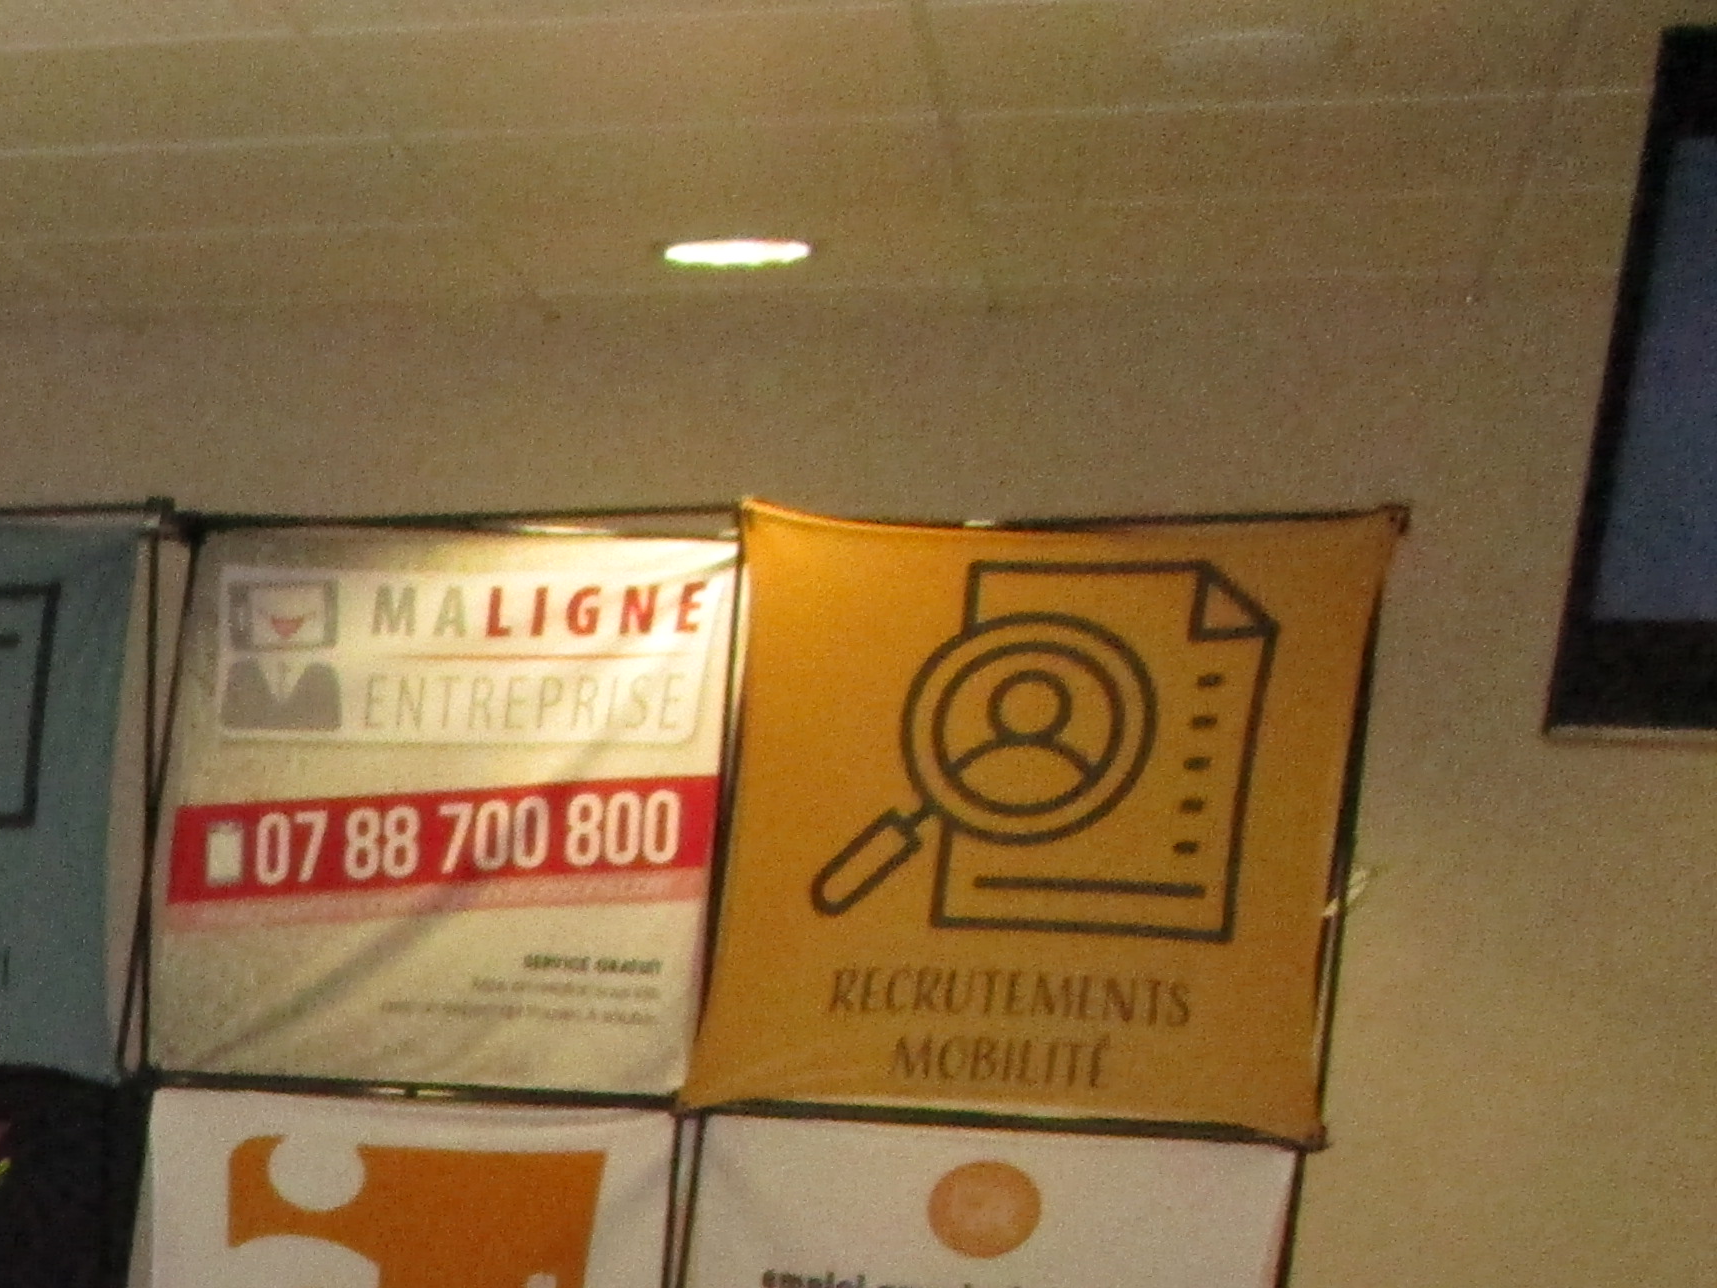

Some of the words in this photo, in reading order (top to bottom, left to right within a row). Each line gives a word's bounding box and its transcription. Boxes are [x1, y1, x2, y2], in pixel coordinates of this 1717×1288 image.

[364, 670, 692, 731] ENTREPRISE
[255, 811, 327, 886] 07
[345, 805, 421, 882] 88
[440, 796, 549, 873] 700
[565, 789, 681, 866] 800
[826, 963, 1191, 1028] RECRUTEMENTS
[889, 1033, 1114, 1089] MOBILITÉ
